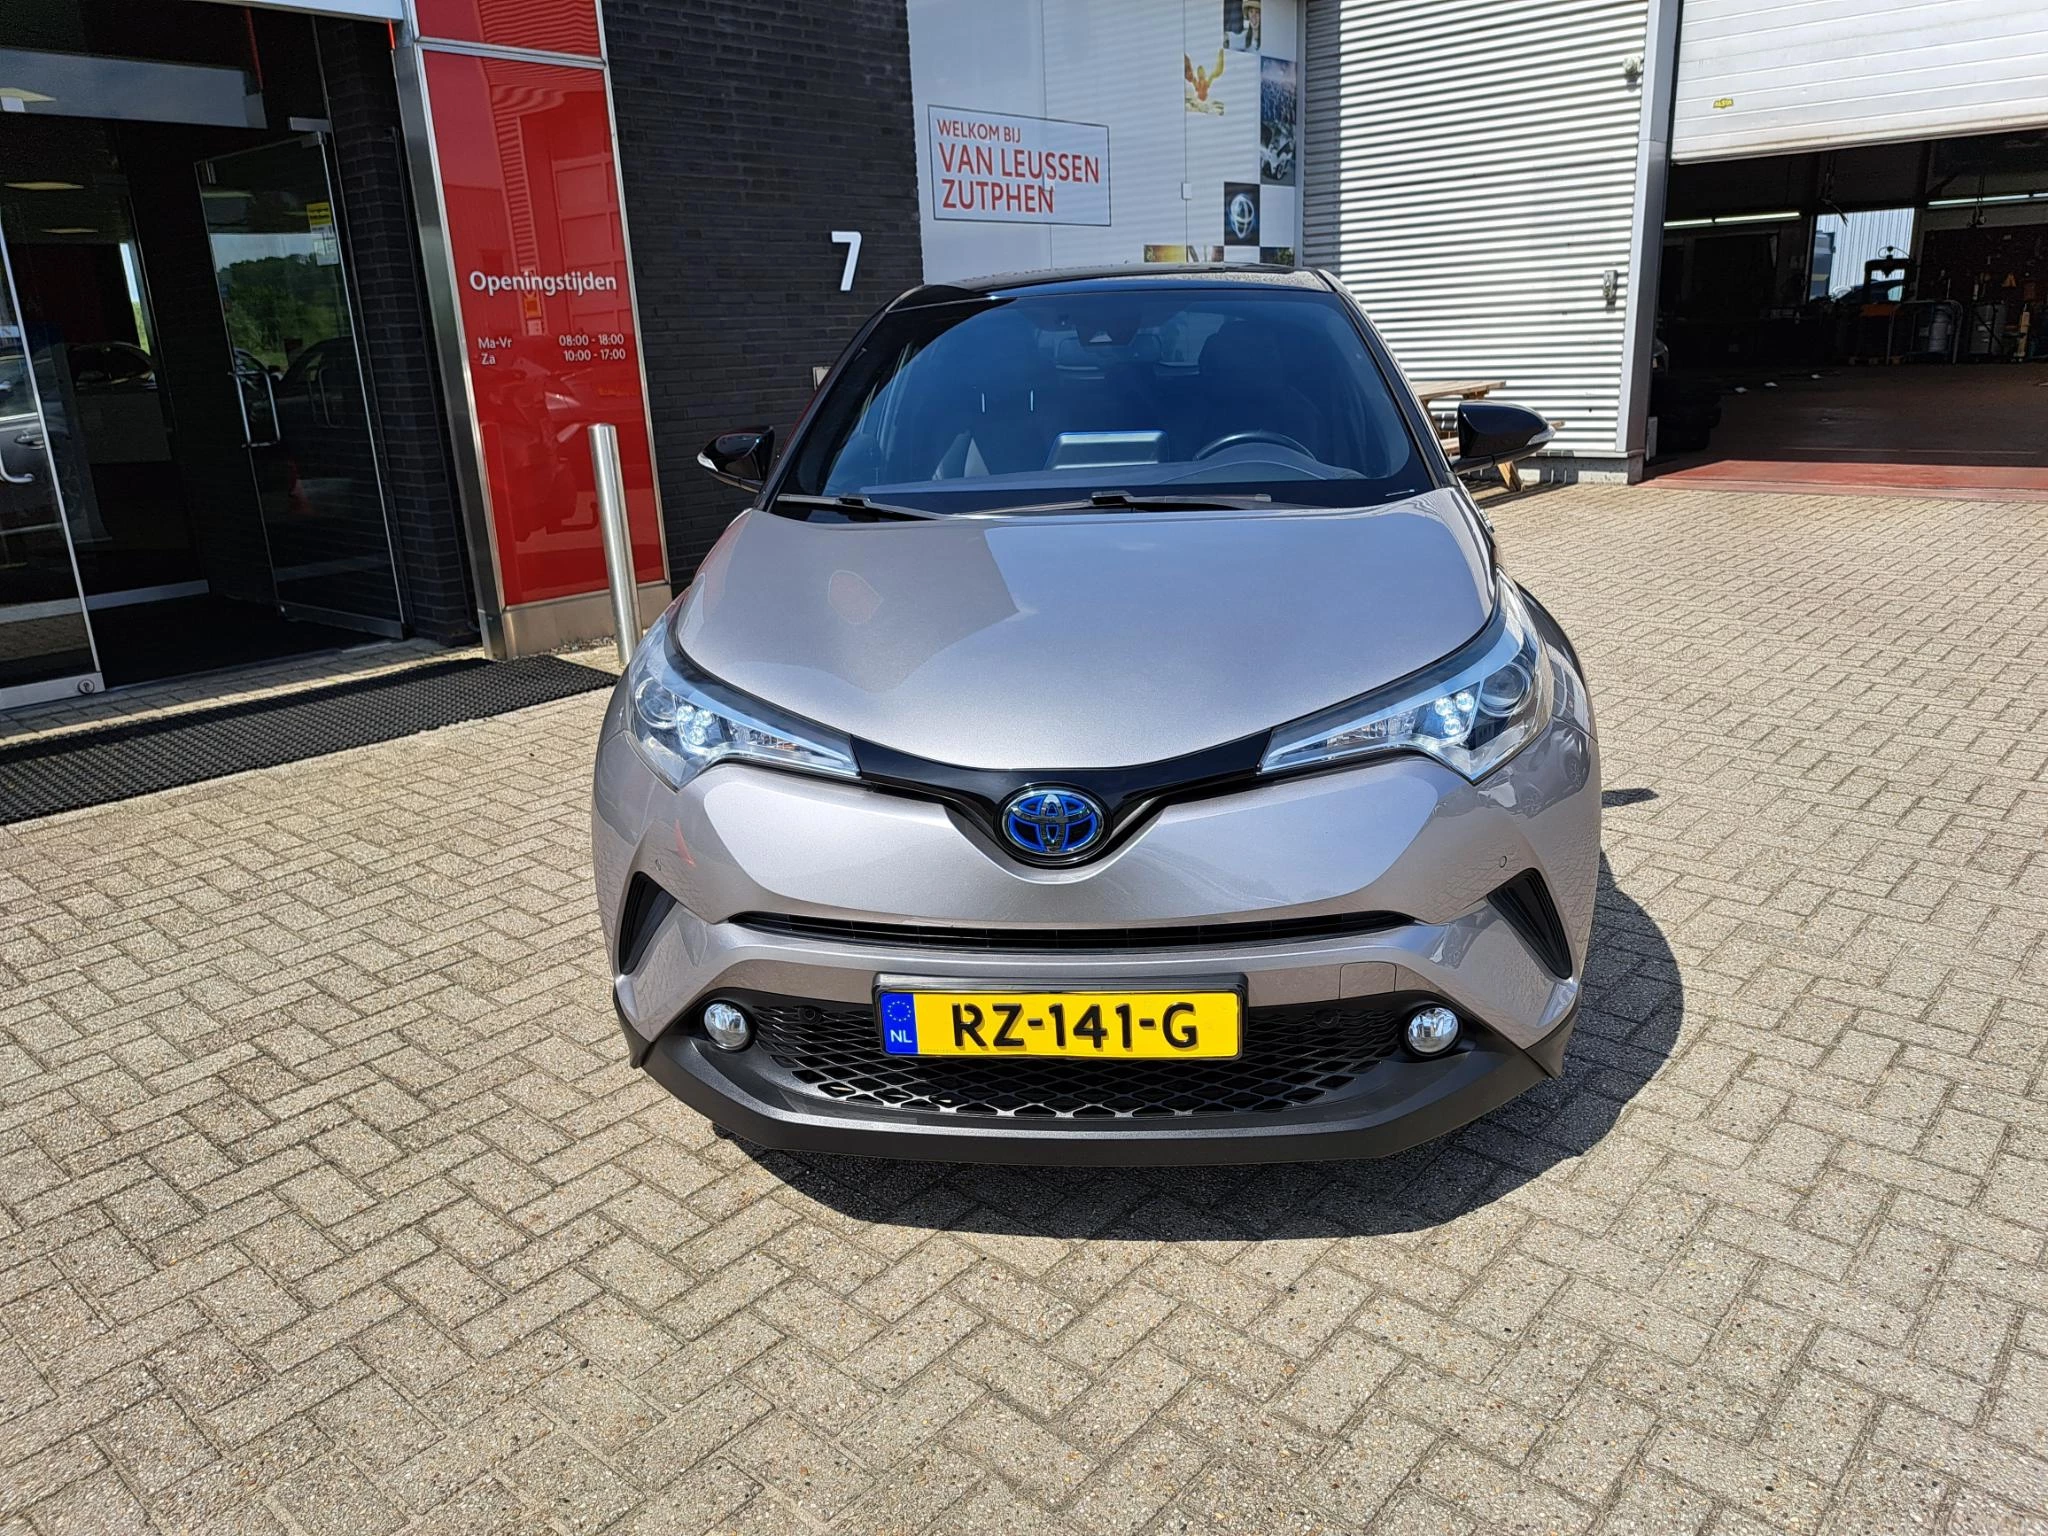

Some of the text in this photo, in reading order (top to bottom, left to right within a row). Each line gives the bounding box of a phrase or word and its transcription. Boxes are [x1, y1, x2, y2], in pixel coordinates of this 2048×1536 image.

[937, 119, 1022, 144] WELKOM BIJ
[938, 142, 1100, 184] VAN LEUSSEN
[941, 179, 1054, 214] ZUTPHEN
[831, 230, 863, 292] 7
[469, 270, 618, 297] Openingstijden
[478, 335, 513, 350] Ma-Vr
[559, 334, 589, 347] 08:00
[598, 333, 625, 346] 18:00
[480, 352, 497, 366] Za
[563, 350, 592, 362] 10:00
[600, 348, 627, 361] 17:00
[890, 1029, 913, 1044] NL
[951, 1001, 1199, 1050] RZ-141-G
